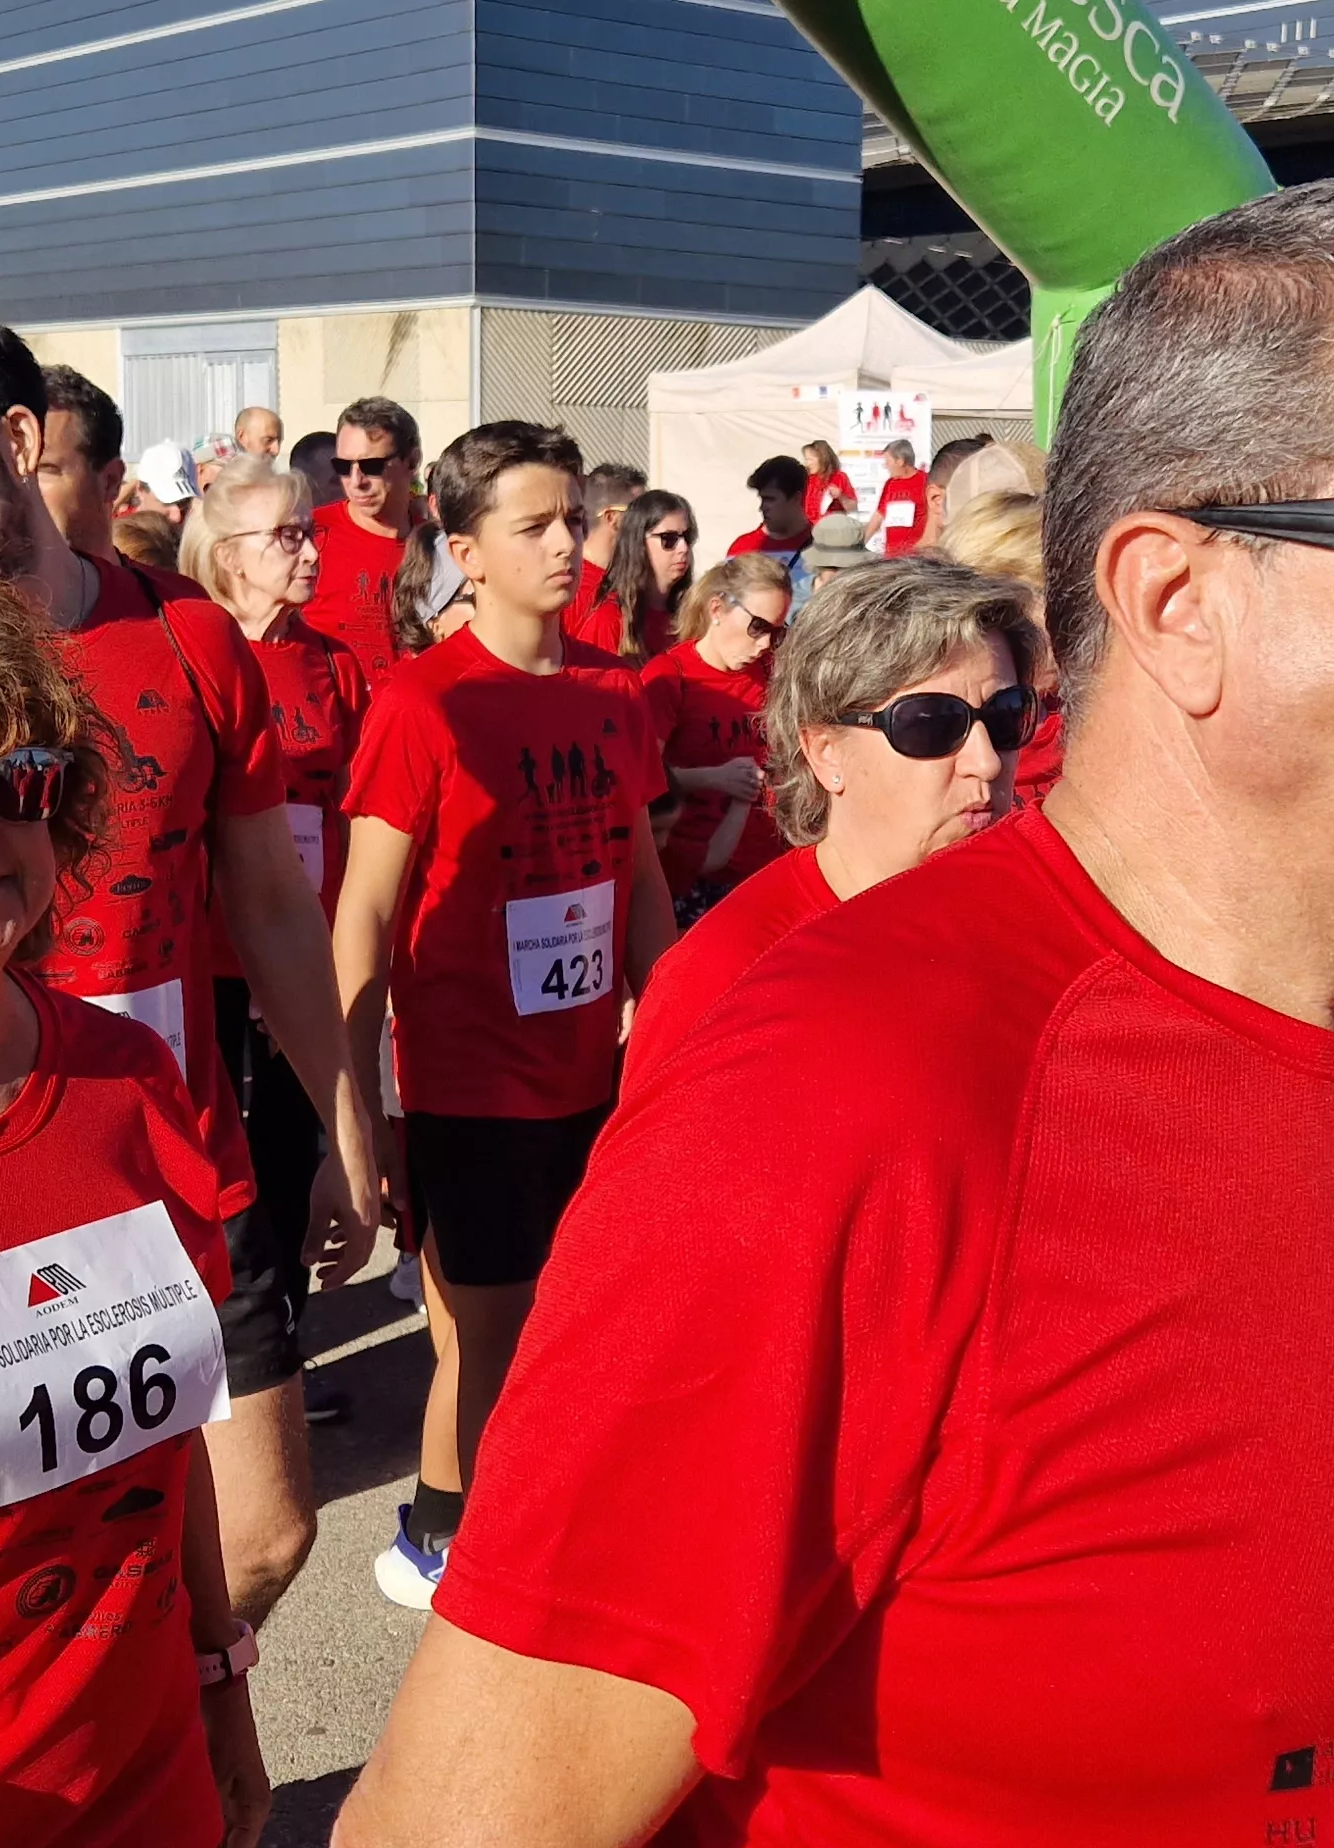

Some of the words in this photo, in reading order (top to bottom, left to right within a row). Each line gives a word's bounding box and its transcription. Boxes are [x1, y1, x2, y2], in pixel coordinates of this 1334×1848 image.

[541, 949, 603, 1000] 423
[35, 1295, 80, 1319] AODEM
[51, 1322, 75, 1351] POR
[71, 1320, 90, 1341] LA
[89, 1295, 152, 1336] ESCLEROSIS
[147, 1279, 198, 1314] MÚLTIPLE
[19, 1343, 177, 1474] 186
